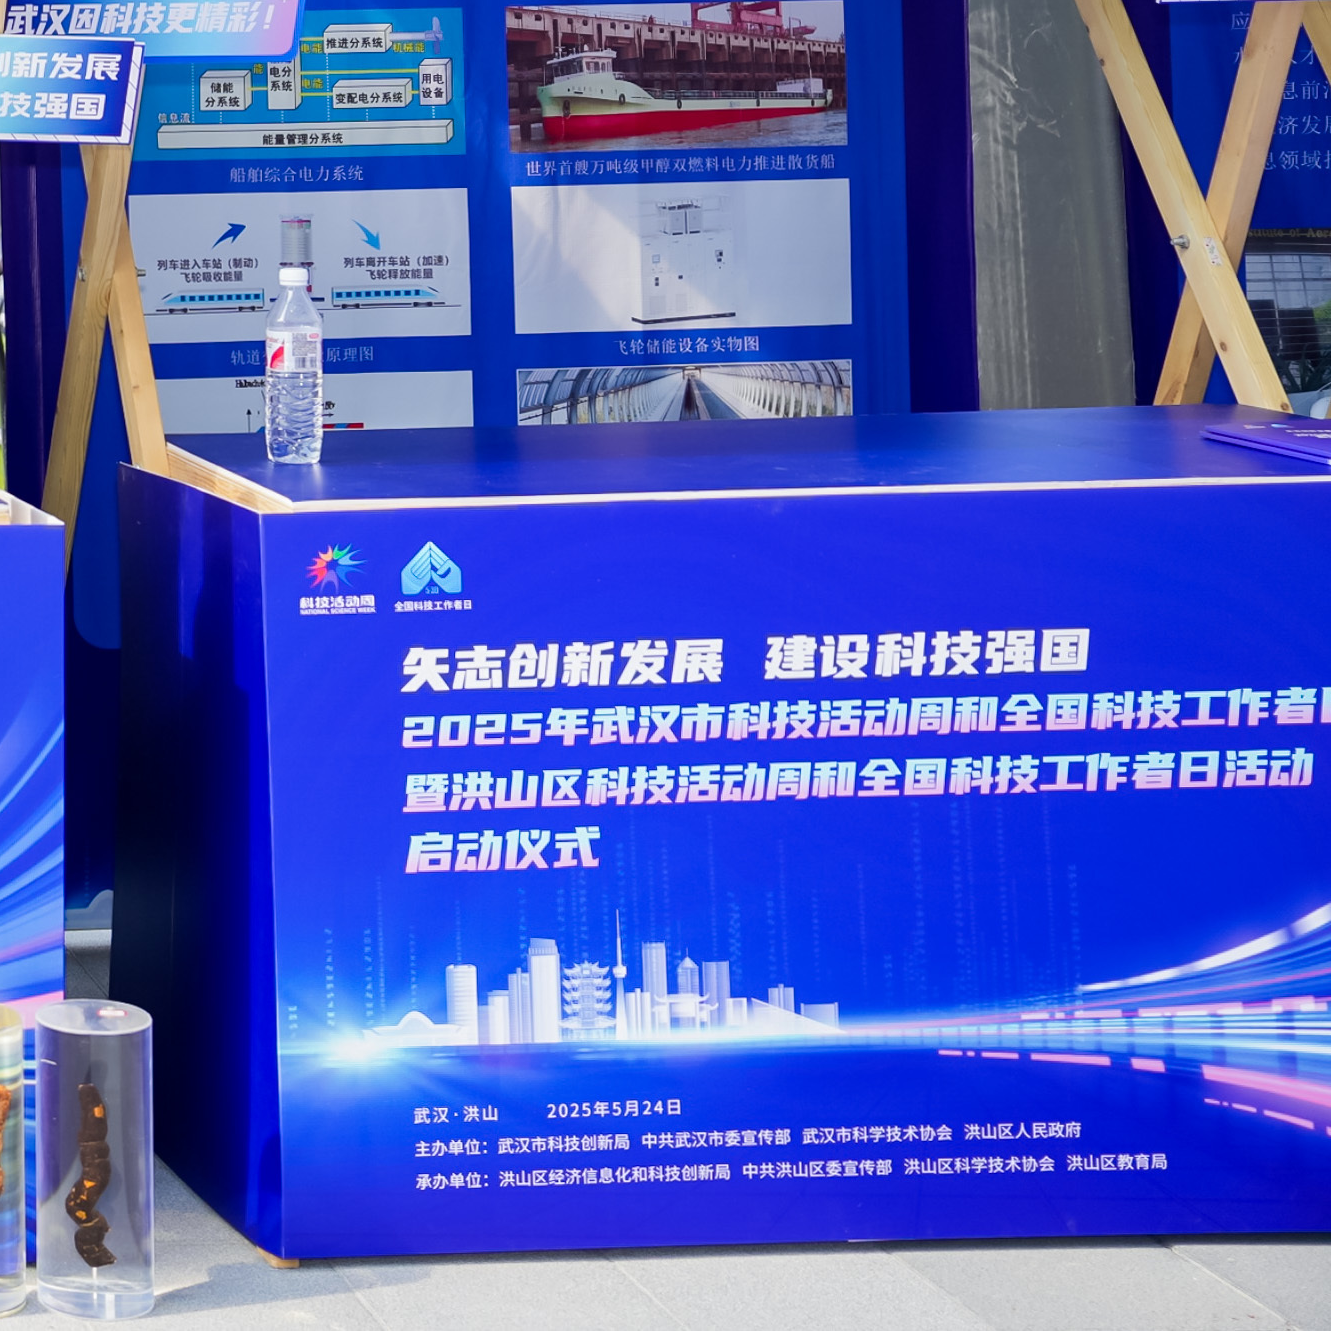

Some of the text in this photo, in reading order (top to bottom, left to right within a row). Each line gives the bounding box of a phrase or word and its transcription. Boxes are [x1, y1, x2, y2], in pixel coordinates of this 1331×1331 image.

[326, 36, 384, 51] 推进分系统
[210, 80, 234, 94] 储能
[270, 79, 294, 93] 系统
[421, 72, 445, 86] 用电
[204, 94, 241, 109] 分系统
[335, 90, 404, 106] 变配电分系统
[421, 86, 446, 100] 设备
[262, 132, 344, 146] 能量管理分系统
[228, 164, 365, 184] 船舶综合电力系统
[525, 153, 836, 179] 世界首艘万吨级甲醇双燃料电力推进散货船
[180, 269, 244, 284] 飞轮吸收能量
[365, 267, 435, 282] 飞轮释放能量
[613, 335, 761, 357] 飞轮储能设备实物图
[298, 594, 473, 613] 科技活动周 全国科技工作者日
[400, 627, 1090, 692] 矢志创新发展 建设科技强国
[402, 747, 1315, 813] 暨洪山区科技活动周和全国科技工作者日活动
[404, 825, 601, 875] 启动仪式
[546, 1098, 683, 1119] 2025年5月24日
[414, 1121, 1082, 1158] 主办单位：武汉市科技创新局 中共武汉市委宣传部 武汉市科学技术协会 洪山区人民政府
[415, 1152, 1168, 1191] 承办单位：洪山区经济信息化和科技创新局 中共洪山区委宣传部 洪山区科学技术协会 洪山区教育局
